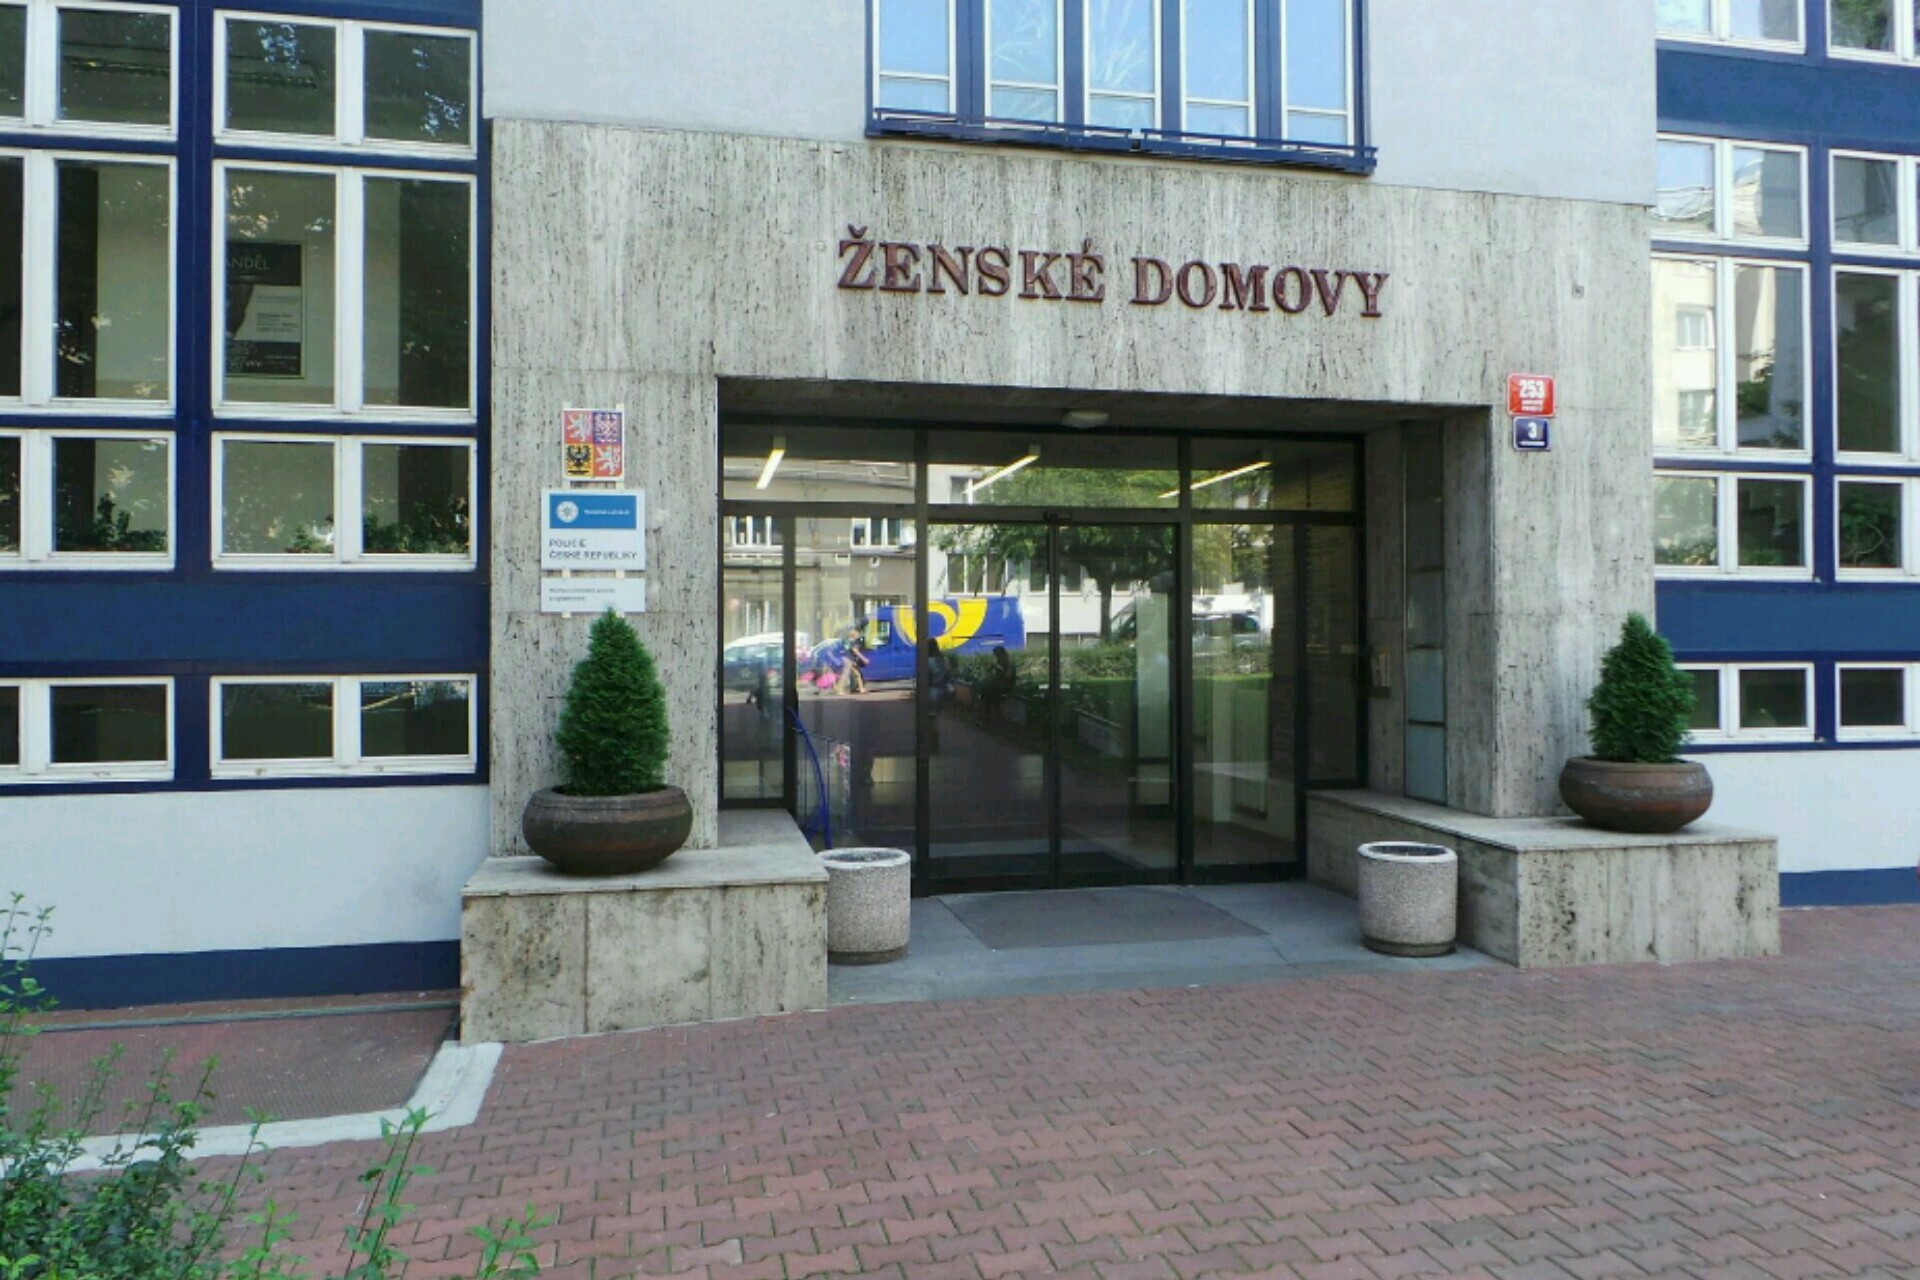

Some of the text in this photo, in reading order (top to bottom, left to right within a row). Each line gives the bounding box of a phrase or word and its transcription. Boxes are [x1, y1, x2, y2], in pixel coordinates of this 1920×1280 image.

[838, 224, 1390, 317] ŽENSKÉ DOMOVY
[1527, 421, 1538, 439] 3
